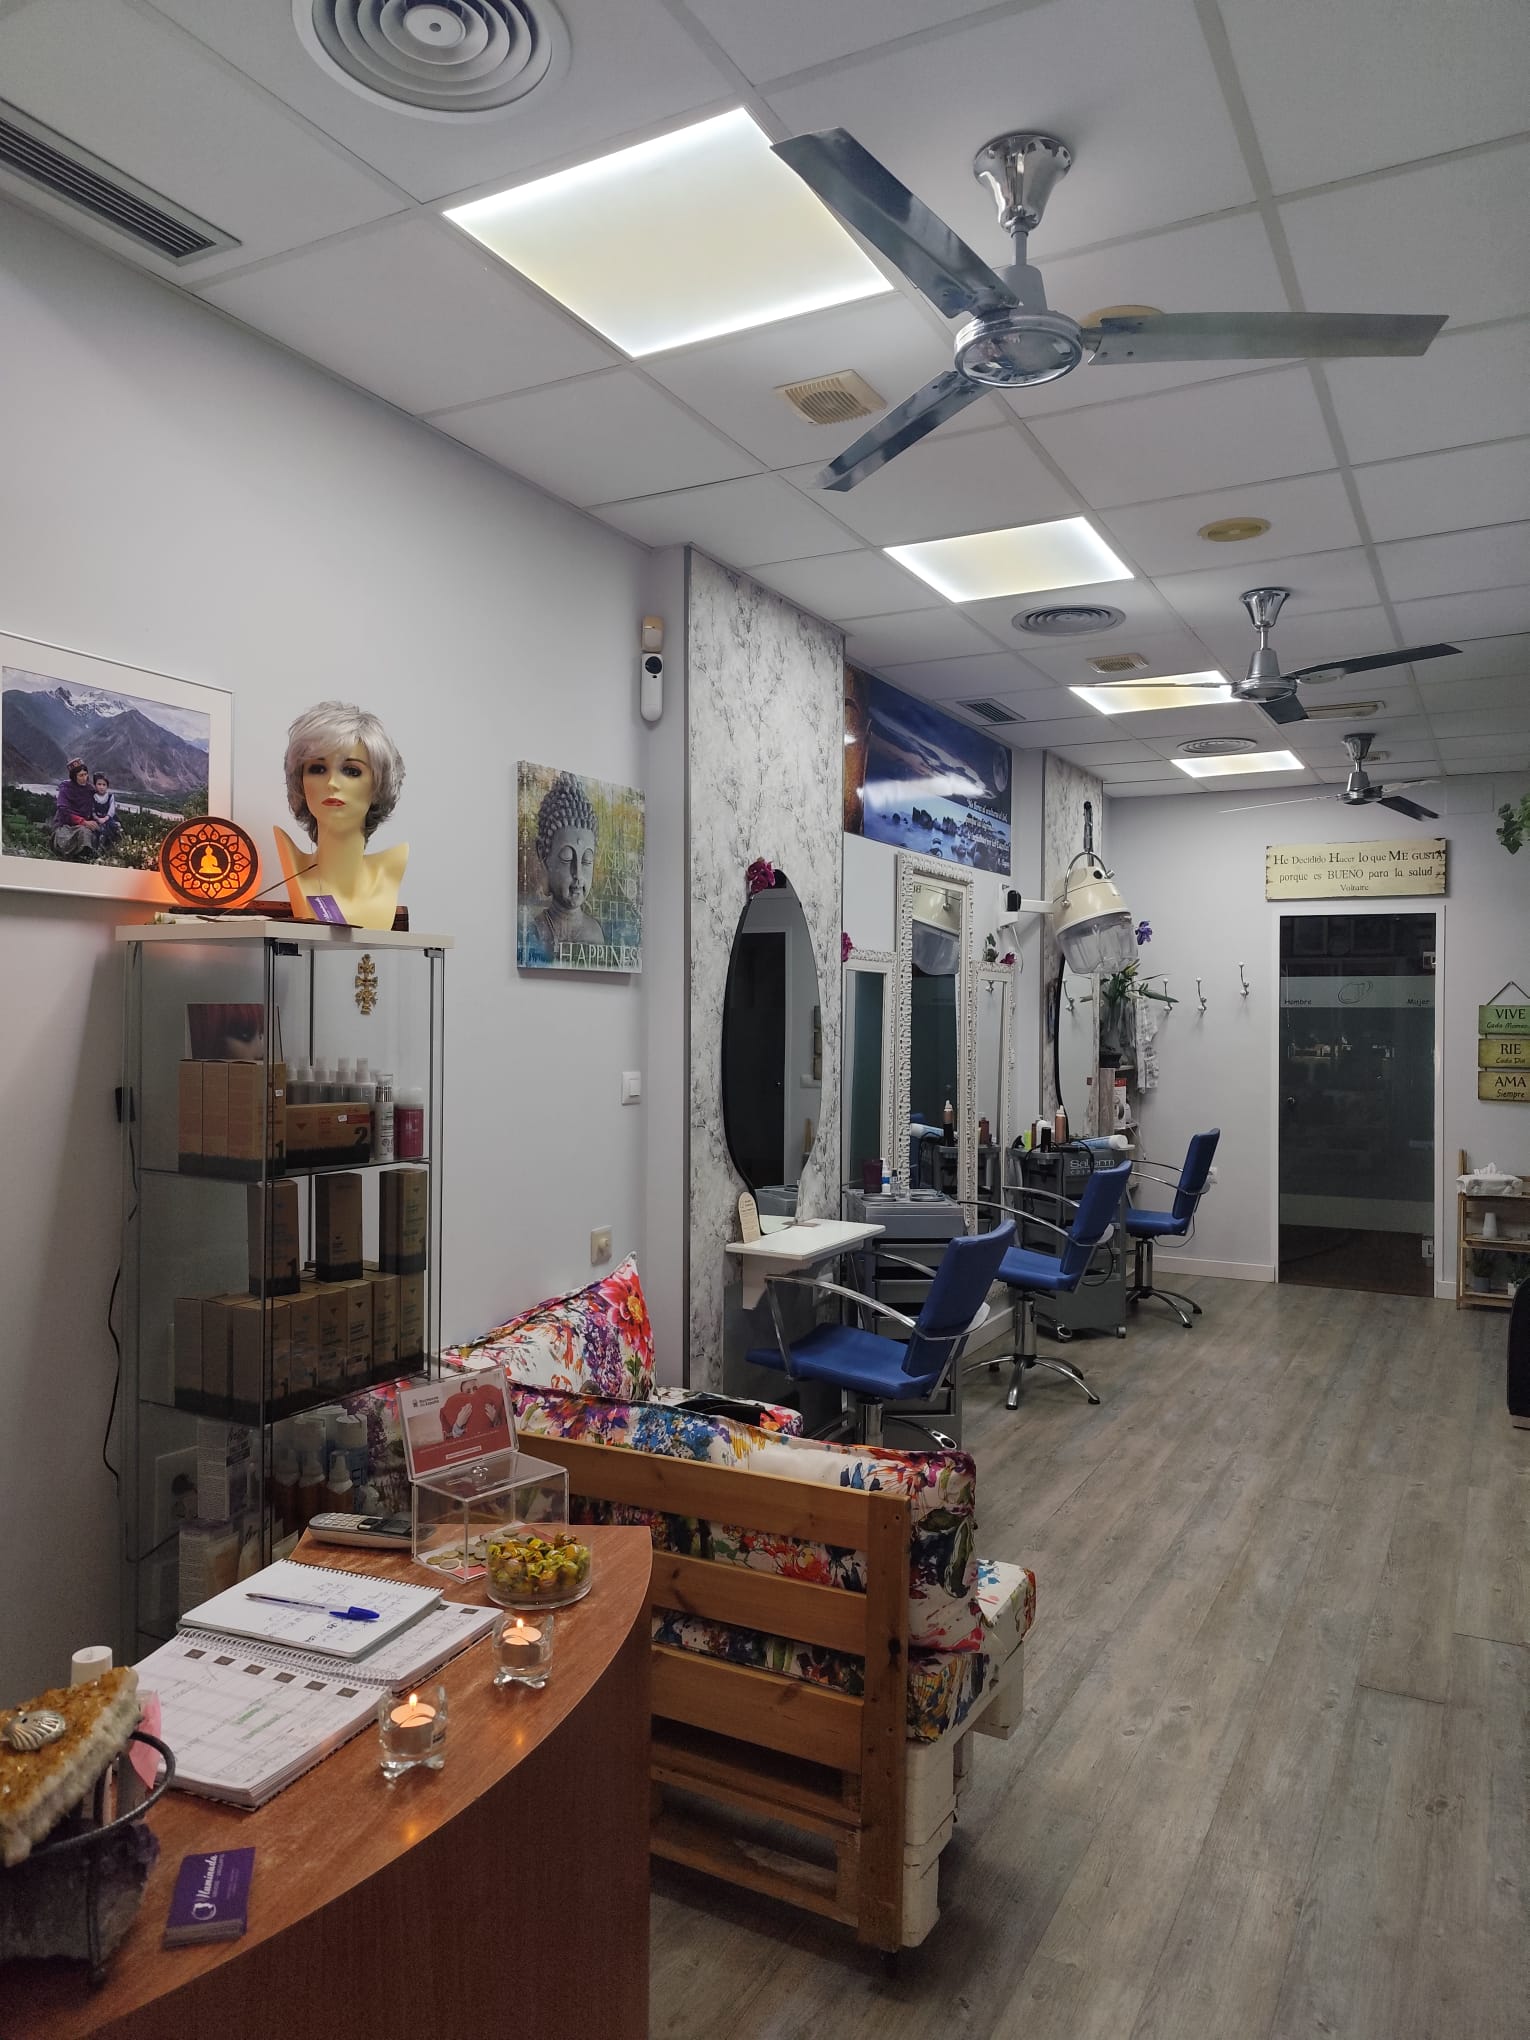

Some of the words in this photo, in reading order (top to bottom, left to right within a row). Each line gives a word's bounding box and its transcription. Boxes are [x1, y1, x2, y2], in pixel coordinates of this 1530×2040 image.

[1273, 854, 1289, 865] He
[1291, 854, 1327, 865] Decidido
[1358, 851, 1369, 863] lo
[1370, 854, 1387, 863] que
[1389, 850, 1409, 861] ME
[1411, 850, 1443, 861] GUSTA
[1279, 872, 1309, 884] porque
[1327, 869, 1364, 880] BUENO
[1368, 869, 1389, 880] para
[1394, 867, 1403, 877] la
[1408, 866, 1433, 877] salud
[1407, 999, 1430, 1007] Mujer
[1495, 1008, 1526, 1020] VIVE
[1500, 1043, 1522, 1055] RIE
[1494, 1076, 1527, 1088] AMA
[1496, 1088, 1526, 1100] Siempre
